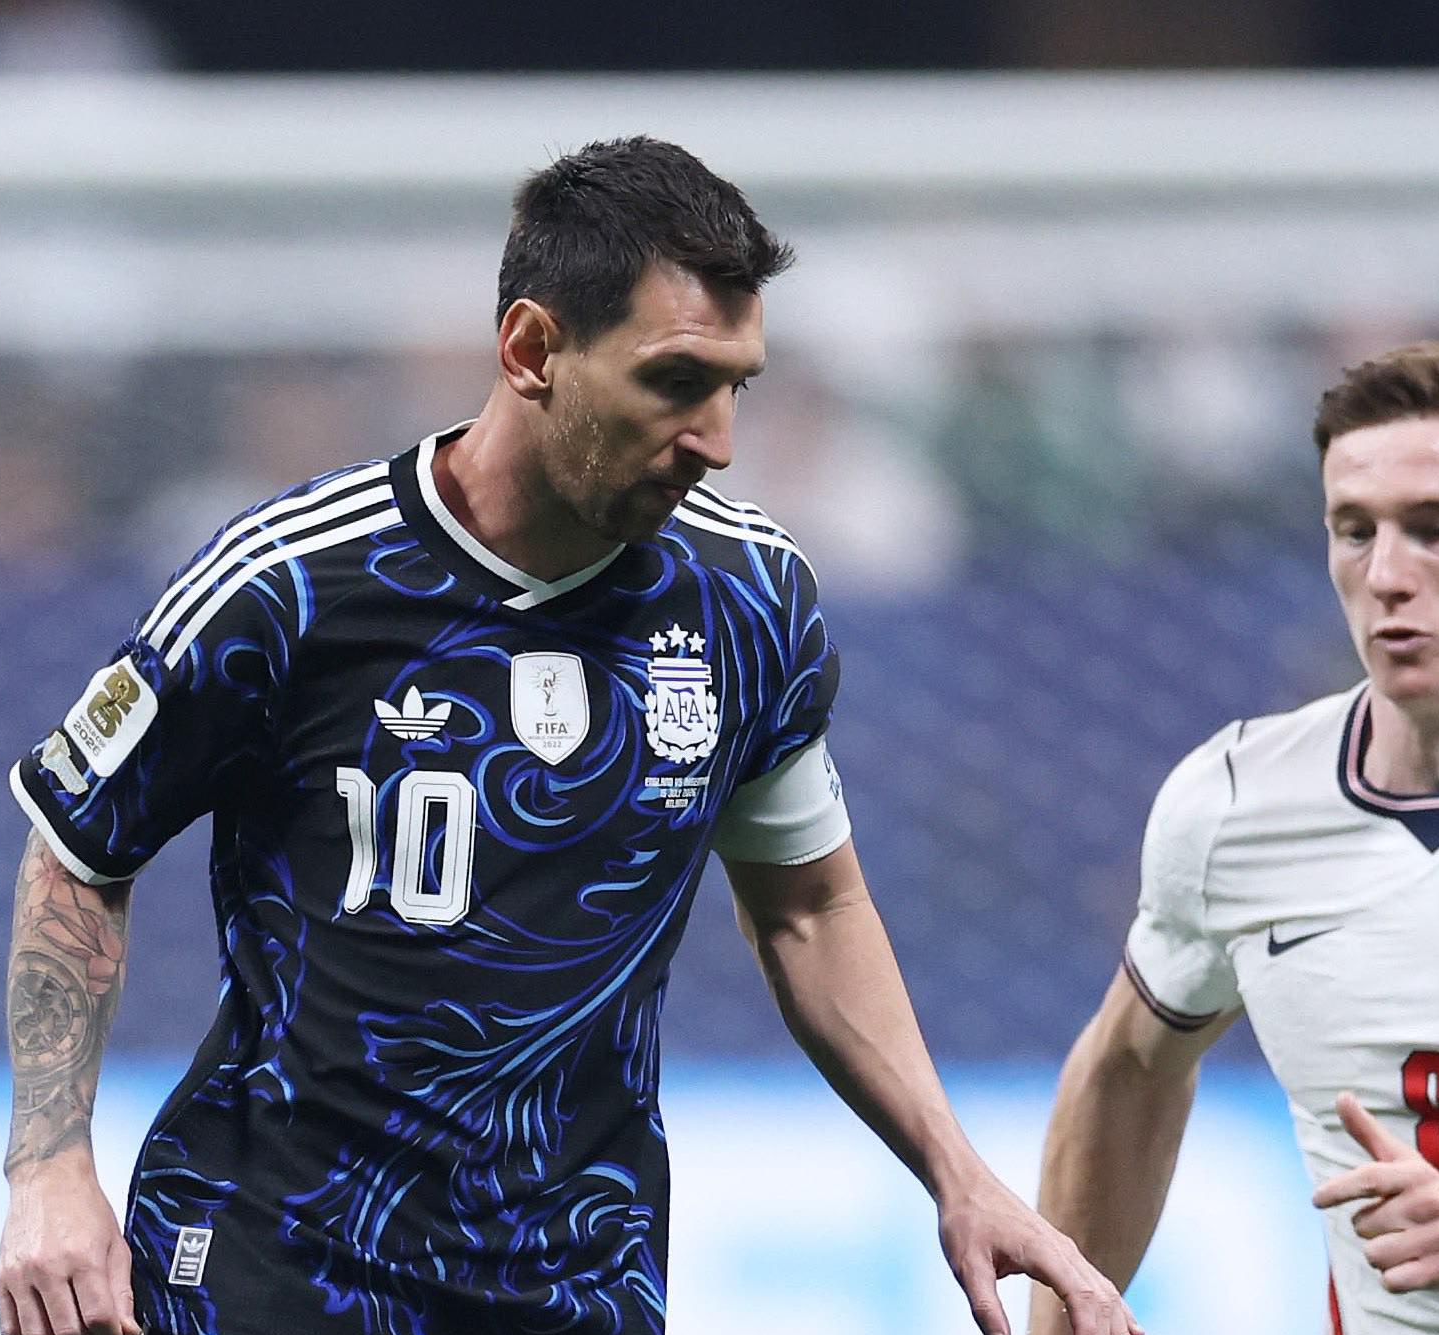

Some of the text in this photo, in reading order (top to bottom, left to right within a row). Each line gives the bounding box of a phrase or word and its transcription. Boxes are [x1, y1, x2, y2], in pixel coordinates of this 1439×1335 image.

[536, 723, 568, 734] FIFA
[662, 686, 703, 732] AFA
[73, 720, 102, 757] 2026
[336, 766, 478, 926] 10
